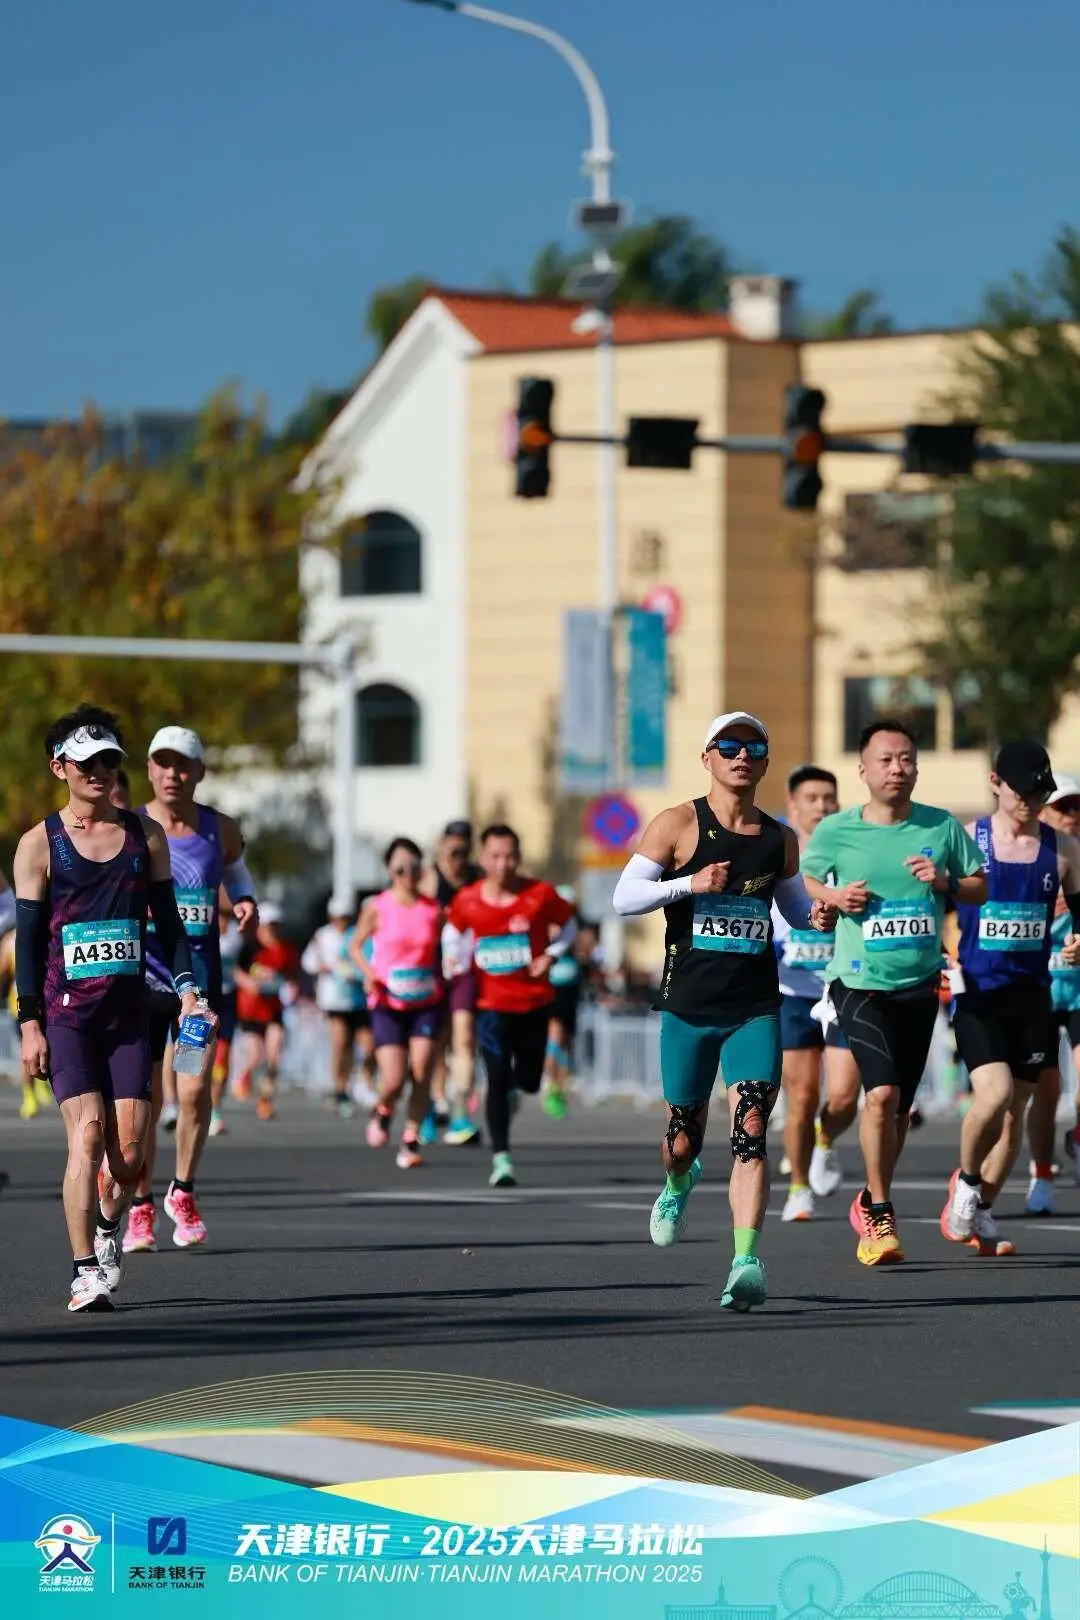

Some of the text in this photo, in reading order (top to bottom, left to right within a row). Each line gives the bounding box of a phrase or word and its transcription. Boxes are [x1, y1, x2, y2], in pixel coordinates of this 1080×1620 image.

[700, 916, 765, 940] A3672
[871, 918, 930, 938] A4701
[986, 922, 1041, 939] B4216
[72, 941, 137, 965] A4381
